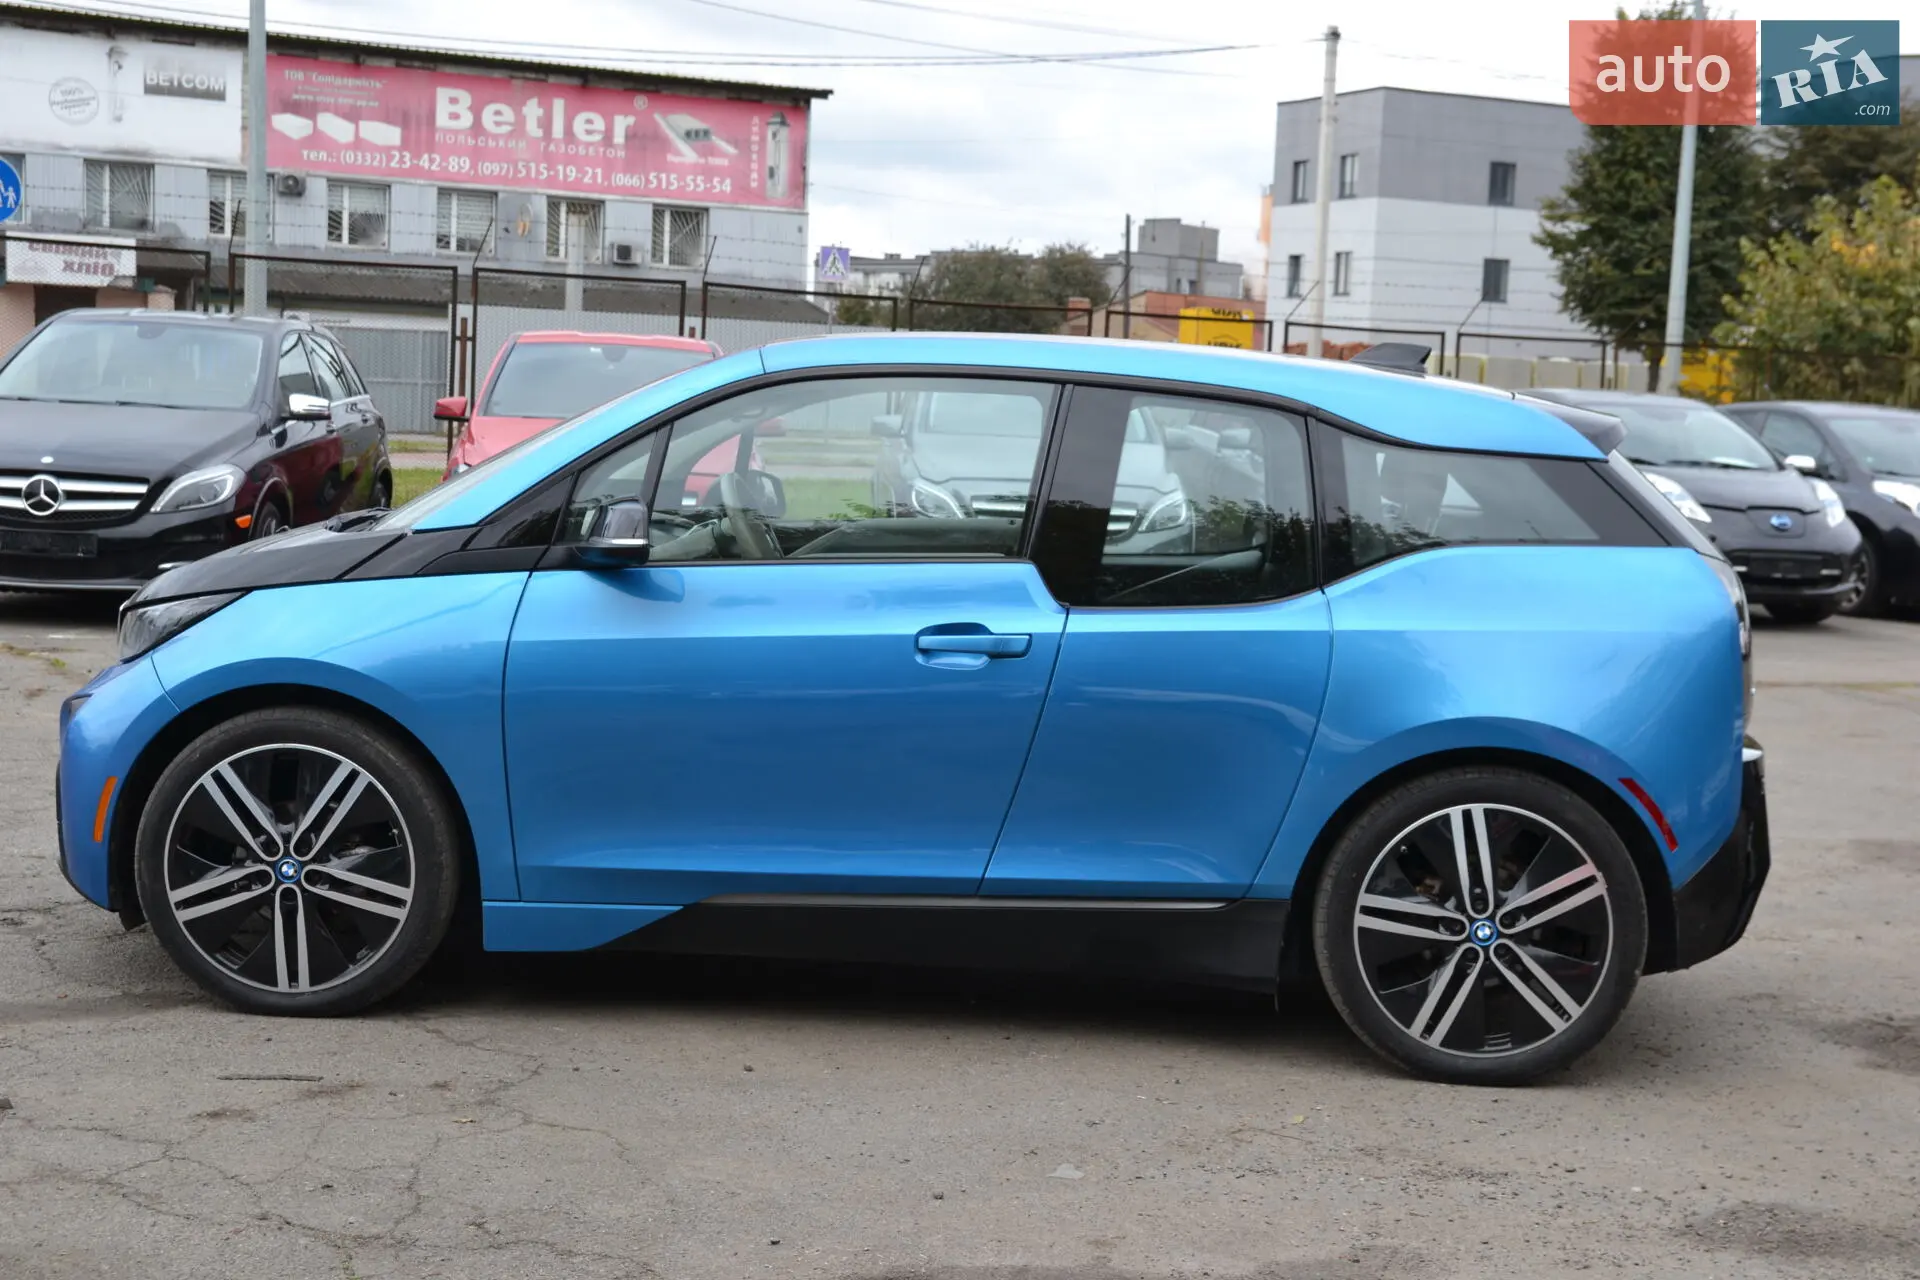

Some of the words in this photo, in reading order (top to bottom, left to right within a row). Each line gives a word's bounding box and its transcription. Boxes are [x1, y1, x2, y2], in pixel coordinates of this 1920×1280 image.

[435, 86, 636, 145] Betler
[341, 150, 386, 168] (0332)
[478, 160, 513, 179] (097)
[611, 172, 645, 190] (066)
[648, 172, 732, 194] 515-55-54
[540, 142, 626, 159] ГАЗОБЕТОН
